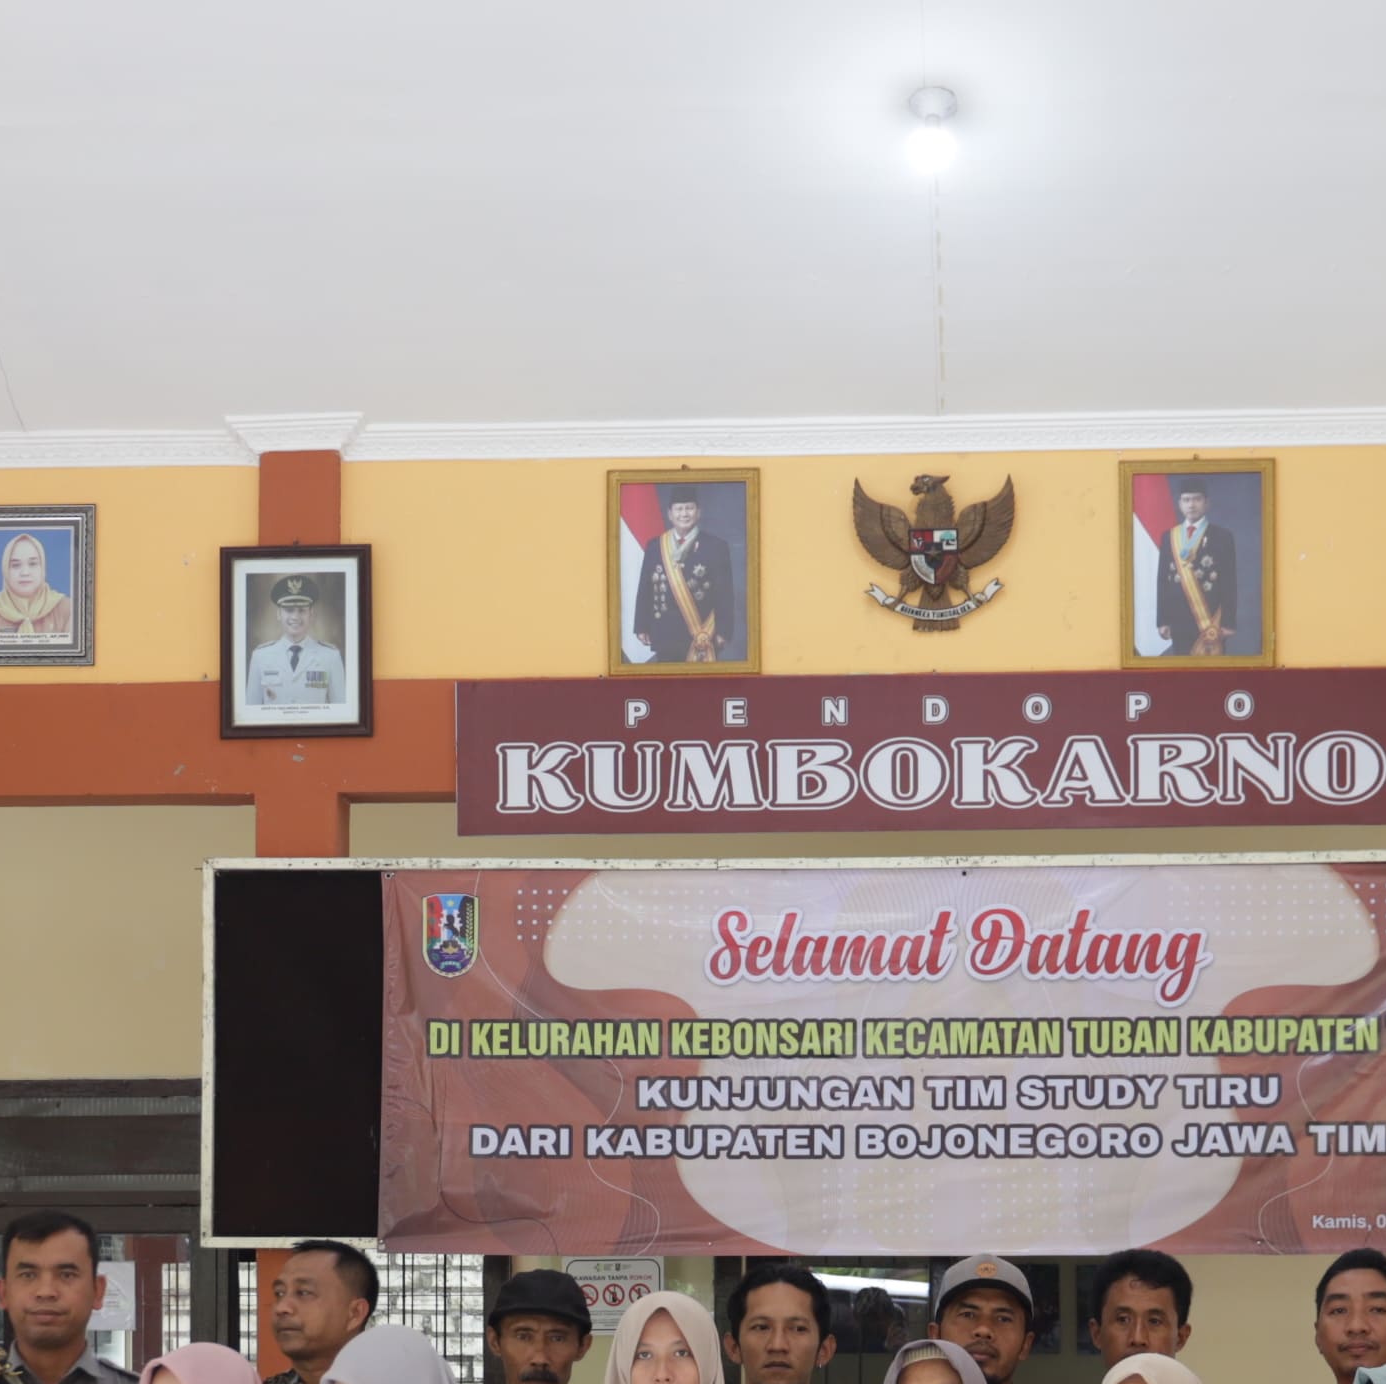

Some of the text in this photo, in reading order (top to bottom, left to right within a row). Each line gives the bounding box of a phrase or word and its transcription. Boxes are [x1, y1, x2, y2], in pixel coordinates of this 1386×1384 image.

[625, 690, 1254, 728] PENDOPO
[707, 906, 1209, 1006] Selamat Datang
[428, 1020, 460, 1058] DI
[470, 1019, 661, 1058] KELURAHAN
[670, 1018, 856, 1057] KEBONSARI
[863, 1018, 1062, 1057] KECAMATAN
[1071, 1017, 1180, 1056] TUBAN
[1188, 1016, 1380, 1055] KABUPATEN
[636, 1075, 1281, 1110] KUNJUNGAN TIM STUDY TIRU
[470, 1126, 571, 1158] DARI
[585, 1125, 843, 1159] KABUPATEN
[856, 1124, 1162, 1158] BOJONEGORO
[1172, 1123, 1297, 1157] JAWA
[1312, 1214, 1373, 1231] Kamis,
